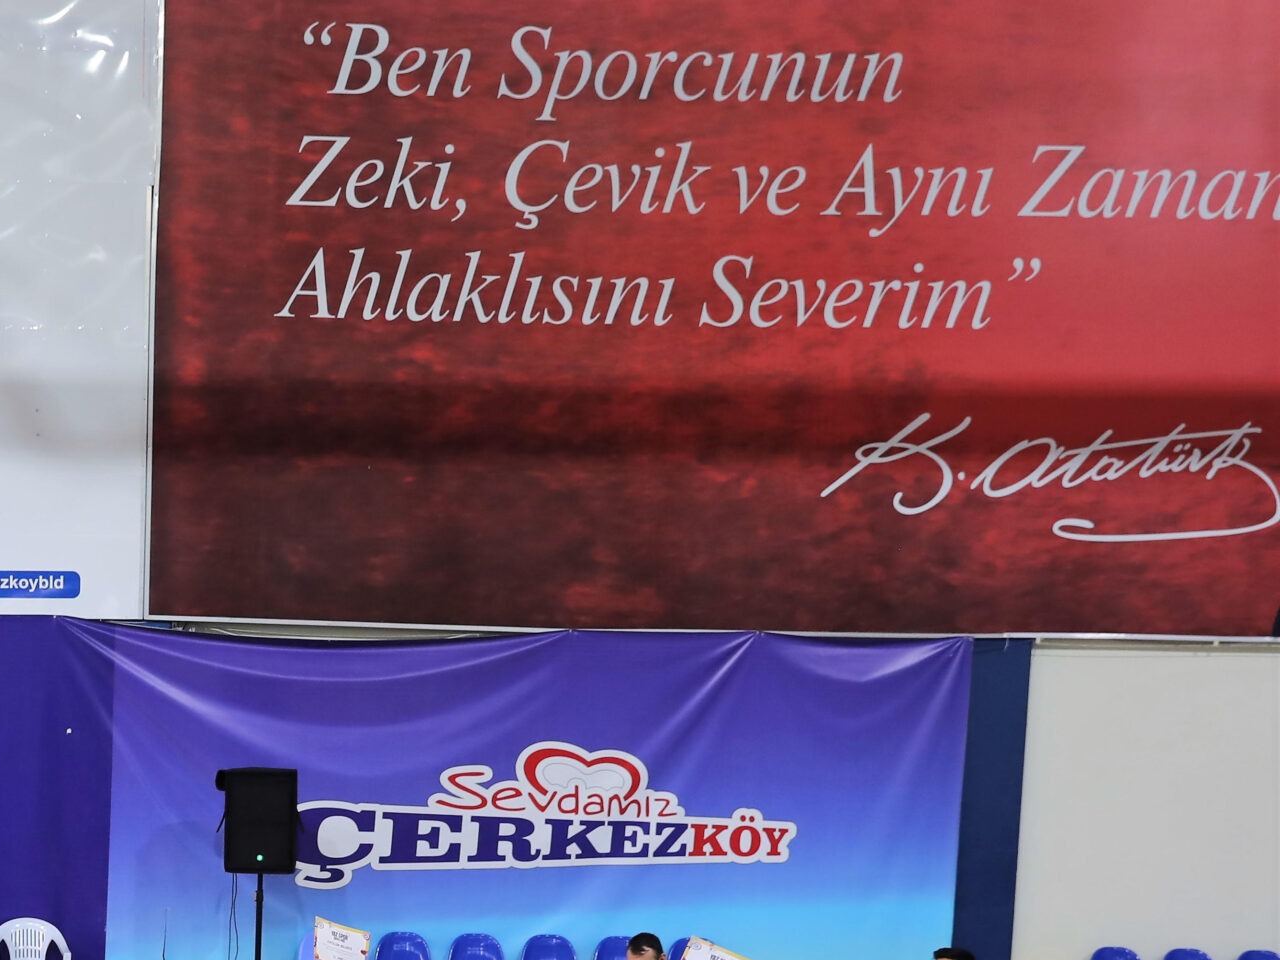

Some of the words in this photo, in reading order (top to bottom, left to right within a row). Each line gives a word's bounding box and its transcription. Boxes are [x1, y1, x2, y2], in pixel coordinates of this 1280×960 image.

[302, 22, 472, 97] “Ben
[499, 25, 904, 120] Sporcunun
[286, 135, 468, 222] Zeki,
[505, 139, 711, 229] Çevik
[733, 168, 808, 216] ve
[822, 144, 990, 237] Aynı
[276, 248, 674, 325] Ahlaklısını
[700, 255, 1042, 330] Severim”
[297, 807, 790, 883] ÇERKEZKÖY
